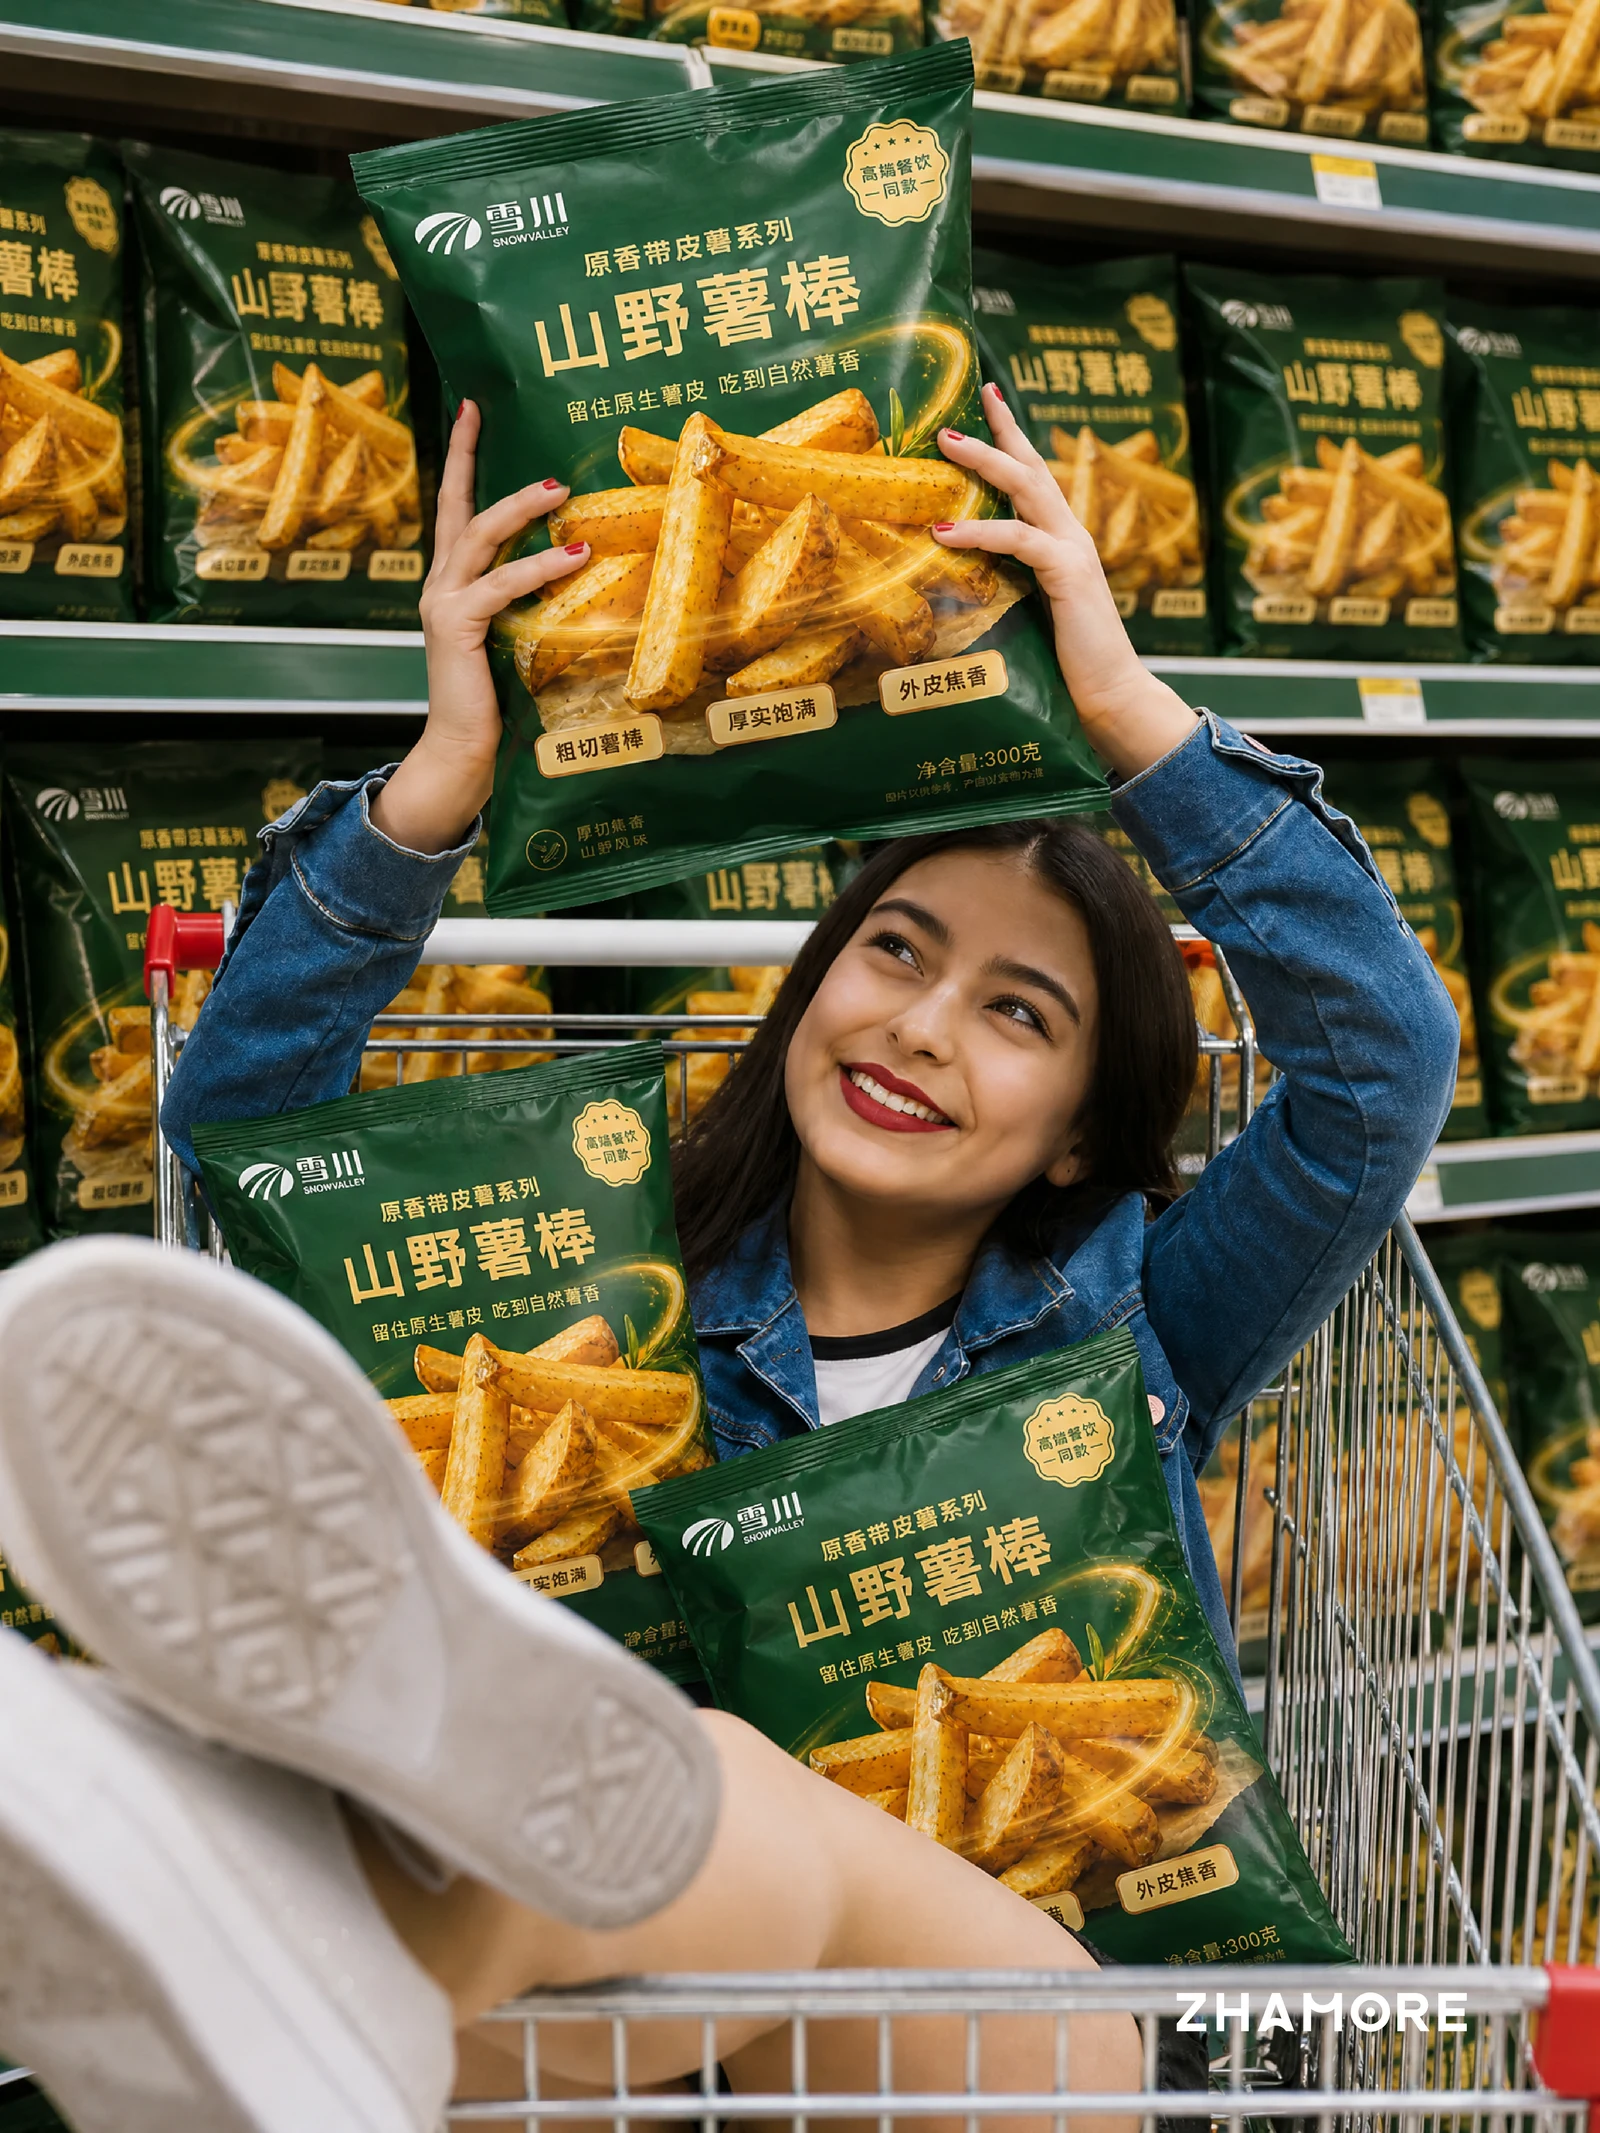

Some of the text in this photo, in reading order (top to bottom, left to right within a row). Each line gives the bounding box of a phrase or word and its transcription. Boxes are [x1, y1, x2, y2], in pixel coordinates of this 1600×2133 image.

[859, 153, 932, 183] 高端餐饮
[882, 177, 918, 199] 同款
[485, 192, 568, 236] 雪川
[492, 225, 570, 248] SNOWVALLEY
[583, 216, 794, 278] 原香带皮薯系列
[231, 267, 385, 330] 山野薯棒
[534, 254, 863, 378] 山野薯棒
[566, 349, 861, 425] 留住原生薯皮 吃到自然薯香
[899, 665, 989, 702] 外皮焦香
[728, 698, 818, 732] 厚实饱满
[555, 728, 644, 764] 粗切薯棒
[917, 741, 1043, 781] 净含量:300克
[107, 856, 254, 915] 山野薯
[296, 1149, 364, 1184] 雪川
[303, 1176, 366, 1195] SNOWVALLEY
[380, 1176, 540, 1223] 原香带皮薯系列
[343, 1207, 597, 1305] 山野薯棒
[371, 1284, 601, 1343] 留住原生薯皮 吃到自然薯香
[1037, 1422, 1098, 1452] 高端餐饮
[1058, 1443, 1089, 1464] 同款
[736, 1491, 802, 1534] 雪川
[743, 1518, 805, 1545] SNOWVALLEY
[820, 1489, 988, 1563] 原香带皮薯系列
[787, 1515, 1052, 1649] 山野薯棒
[819, 1594, 1058, 1685] 留住原生薯皮 吃到自然薯香
[1136, 1858, 1218, 1901] 外皮焦香
